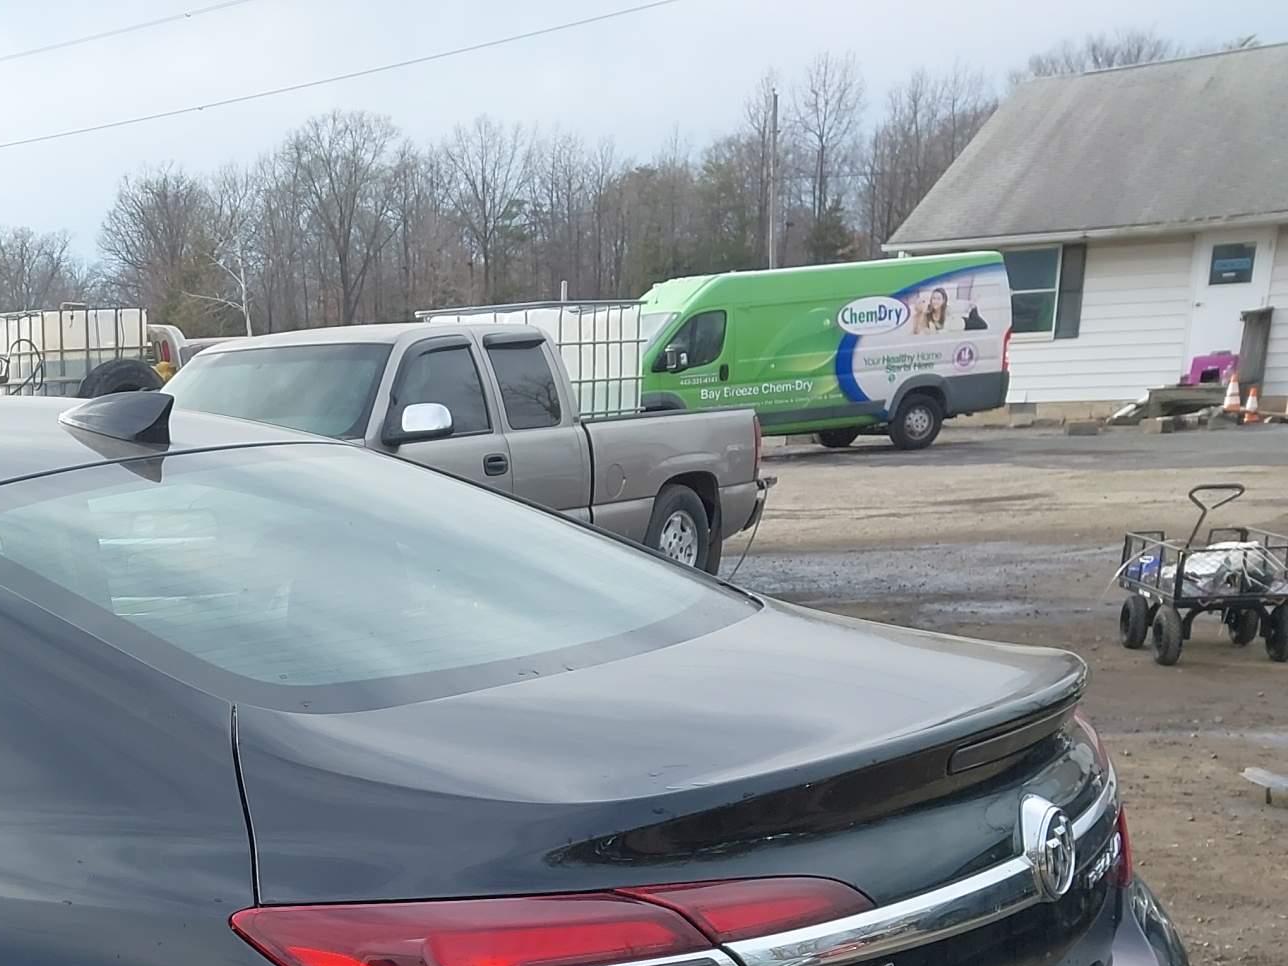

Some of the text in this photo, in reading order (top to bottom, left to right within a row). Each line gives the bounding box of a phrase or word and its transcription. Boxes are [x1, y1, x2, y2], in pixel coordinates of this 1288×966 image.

[841, 304, 903, 325] ChemDry
[863, 351, 942, 367] Your Healthy Home
[700, 388, 721, 401] Bay
[724, 385, 759, 398] Breeze
[761, 379, 813, 394] Chem-Dry
